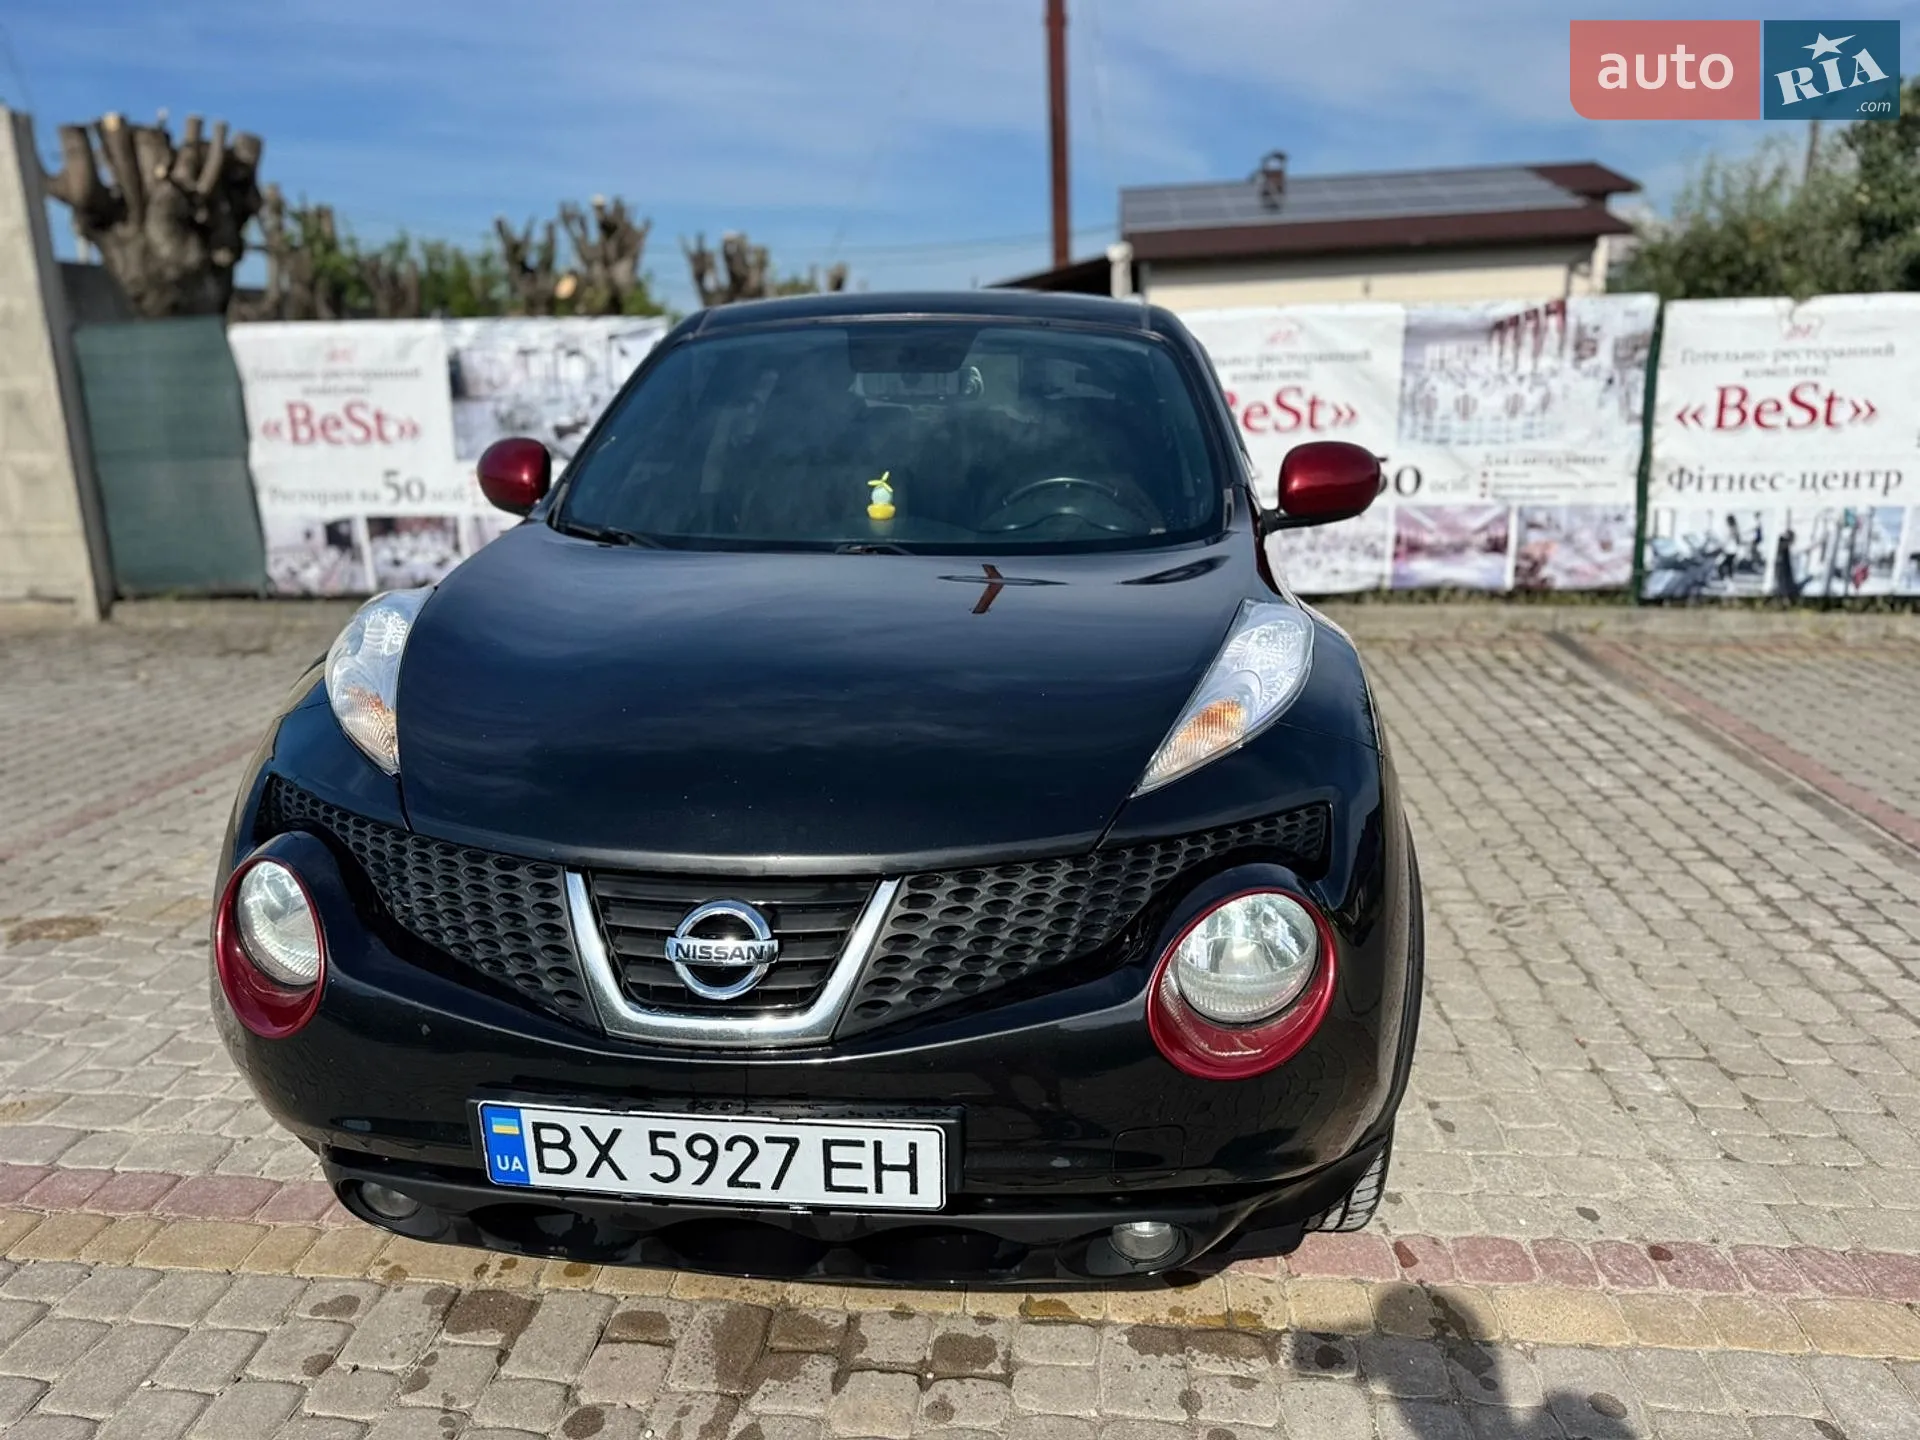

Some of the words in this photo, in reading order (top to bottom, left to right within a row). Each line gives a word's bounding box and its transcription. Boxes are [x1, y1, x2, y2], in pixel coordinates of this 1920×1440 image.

[383, 470, 427, 503] 50
[1667, 465, 1904, 497] Фітнес-центр
[674, 942, 765, 961] NISSAN
[496, 1154, 525, 1173] UA
[532, 1121, 628, 1181] BX
[649, 1130, 801, 1191] 5927
[822, 1138, 919, 1195] EH
